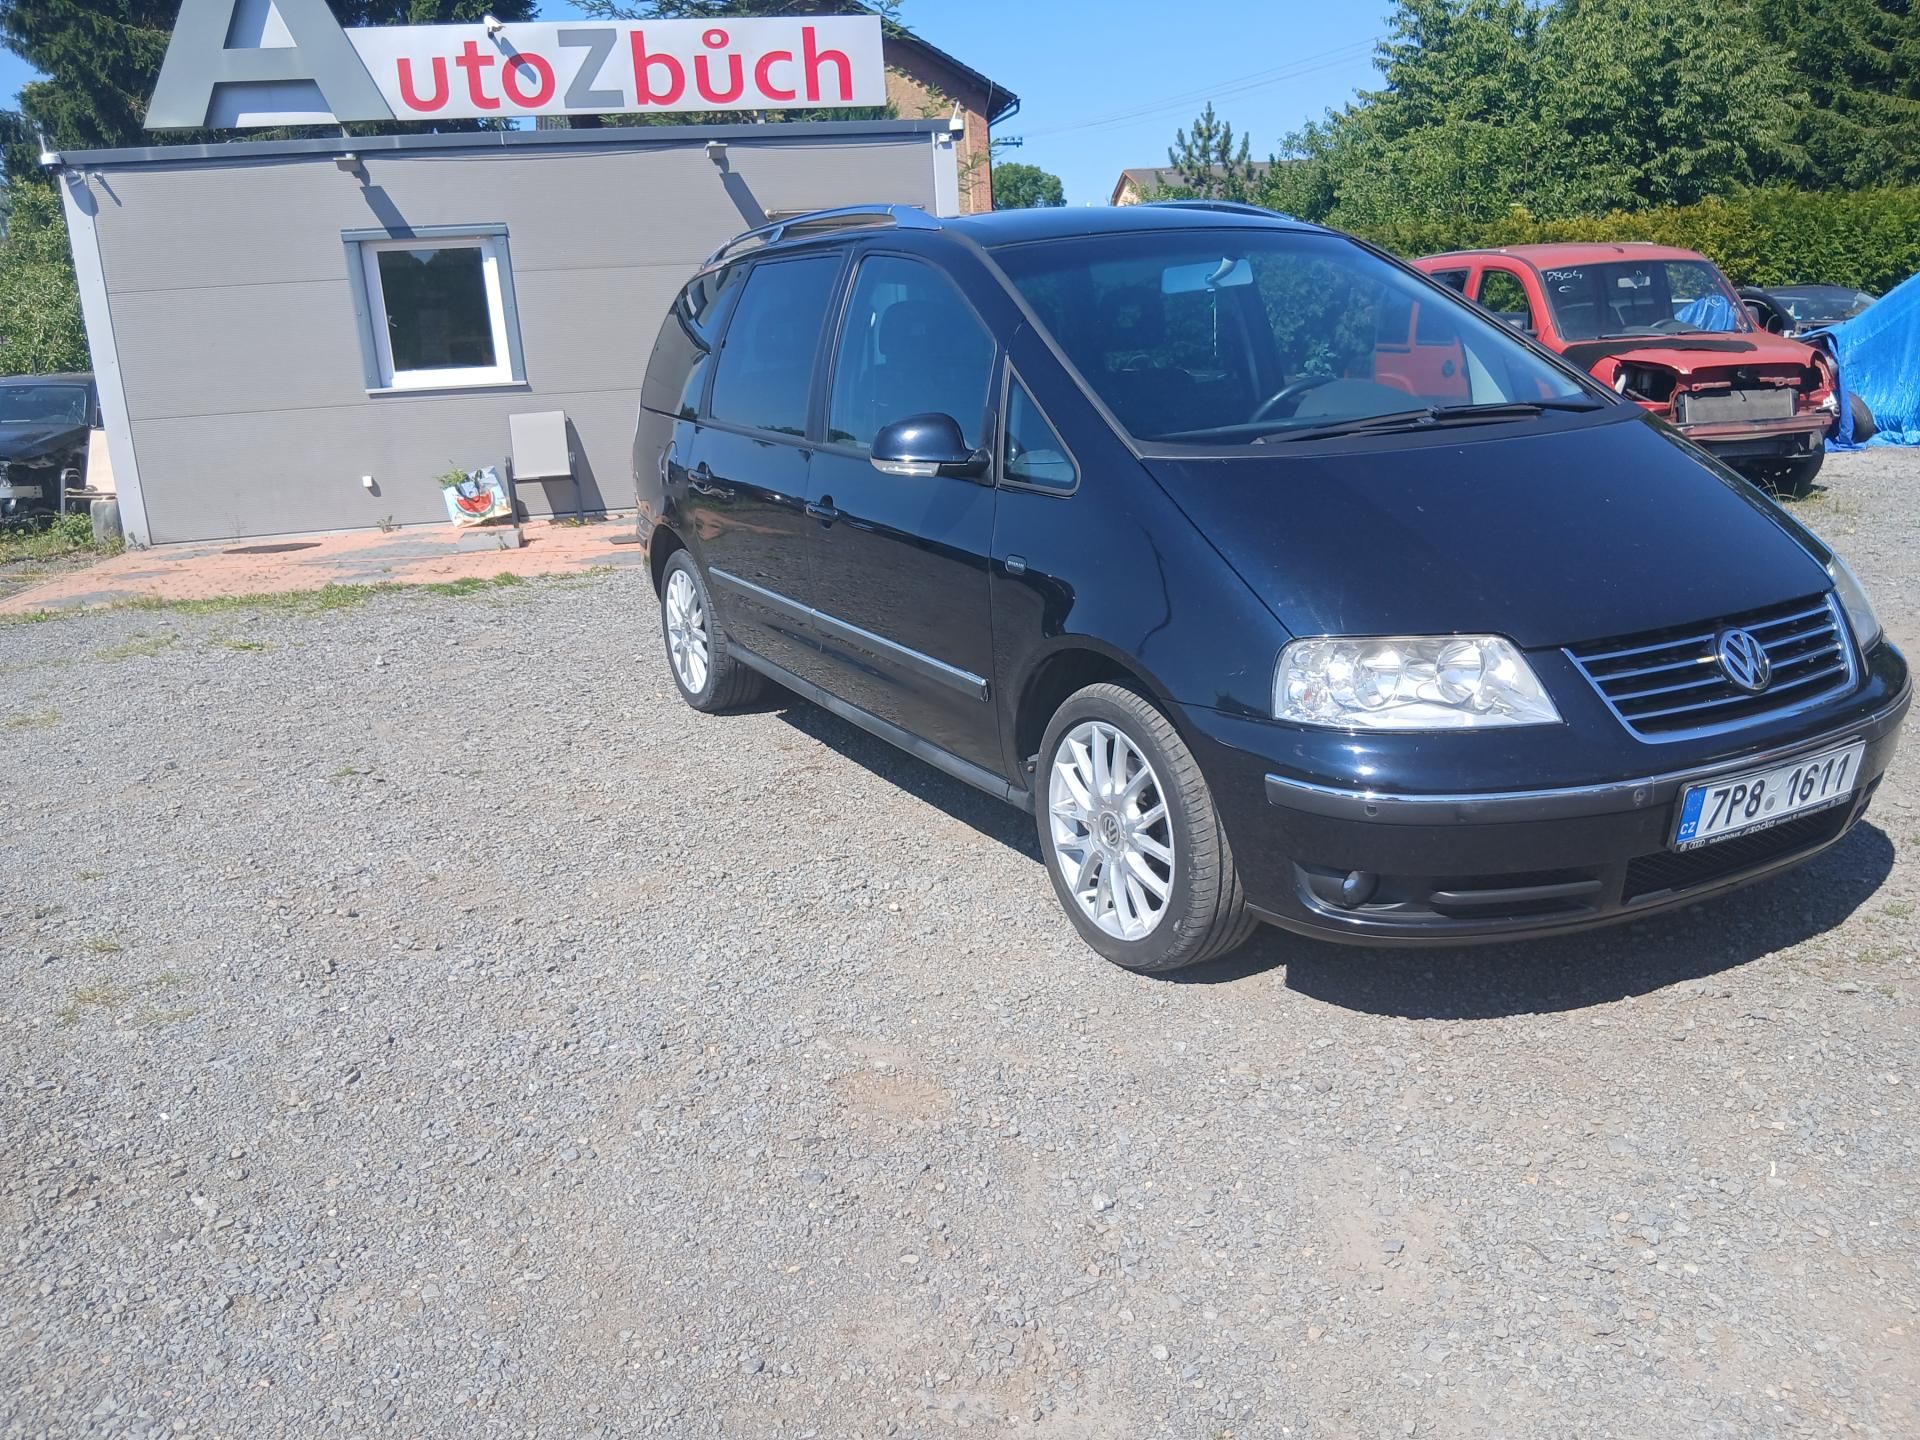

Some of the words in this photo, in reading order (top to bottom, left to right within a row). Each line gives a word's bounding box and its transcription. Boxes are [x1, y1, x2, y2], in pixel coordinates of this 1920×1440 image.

[1704, 779, 1766, 831] 7P8
[1787, 753, 1851, 807] 1611
[1680, 821, 1696, 835] CZ
